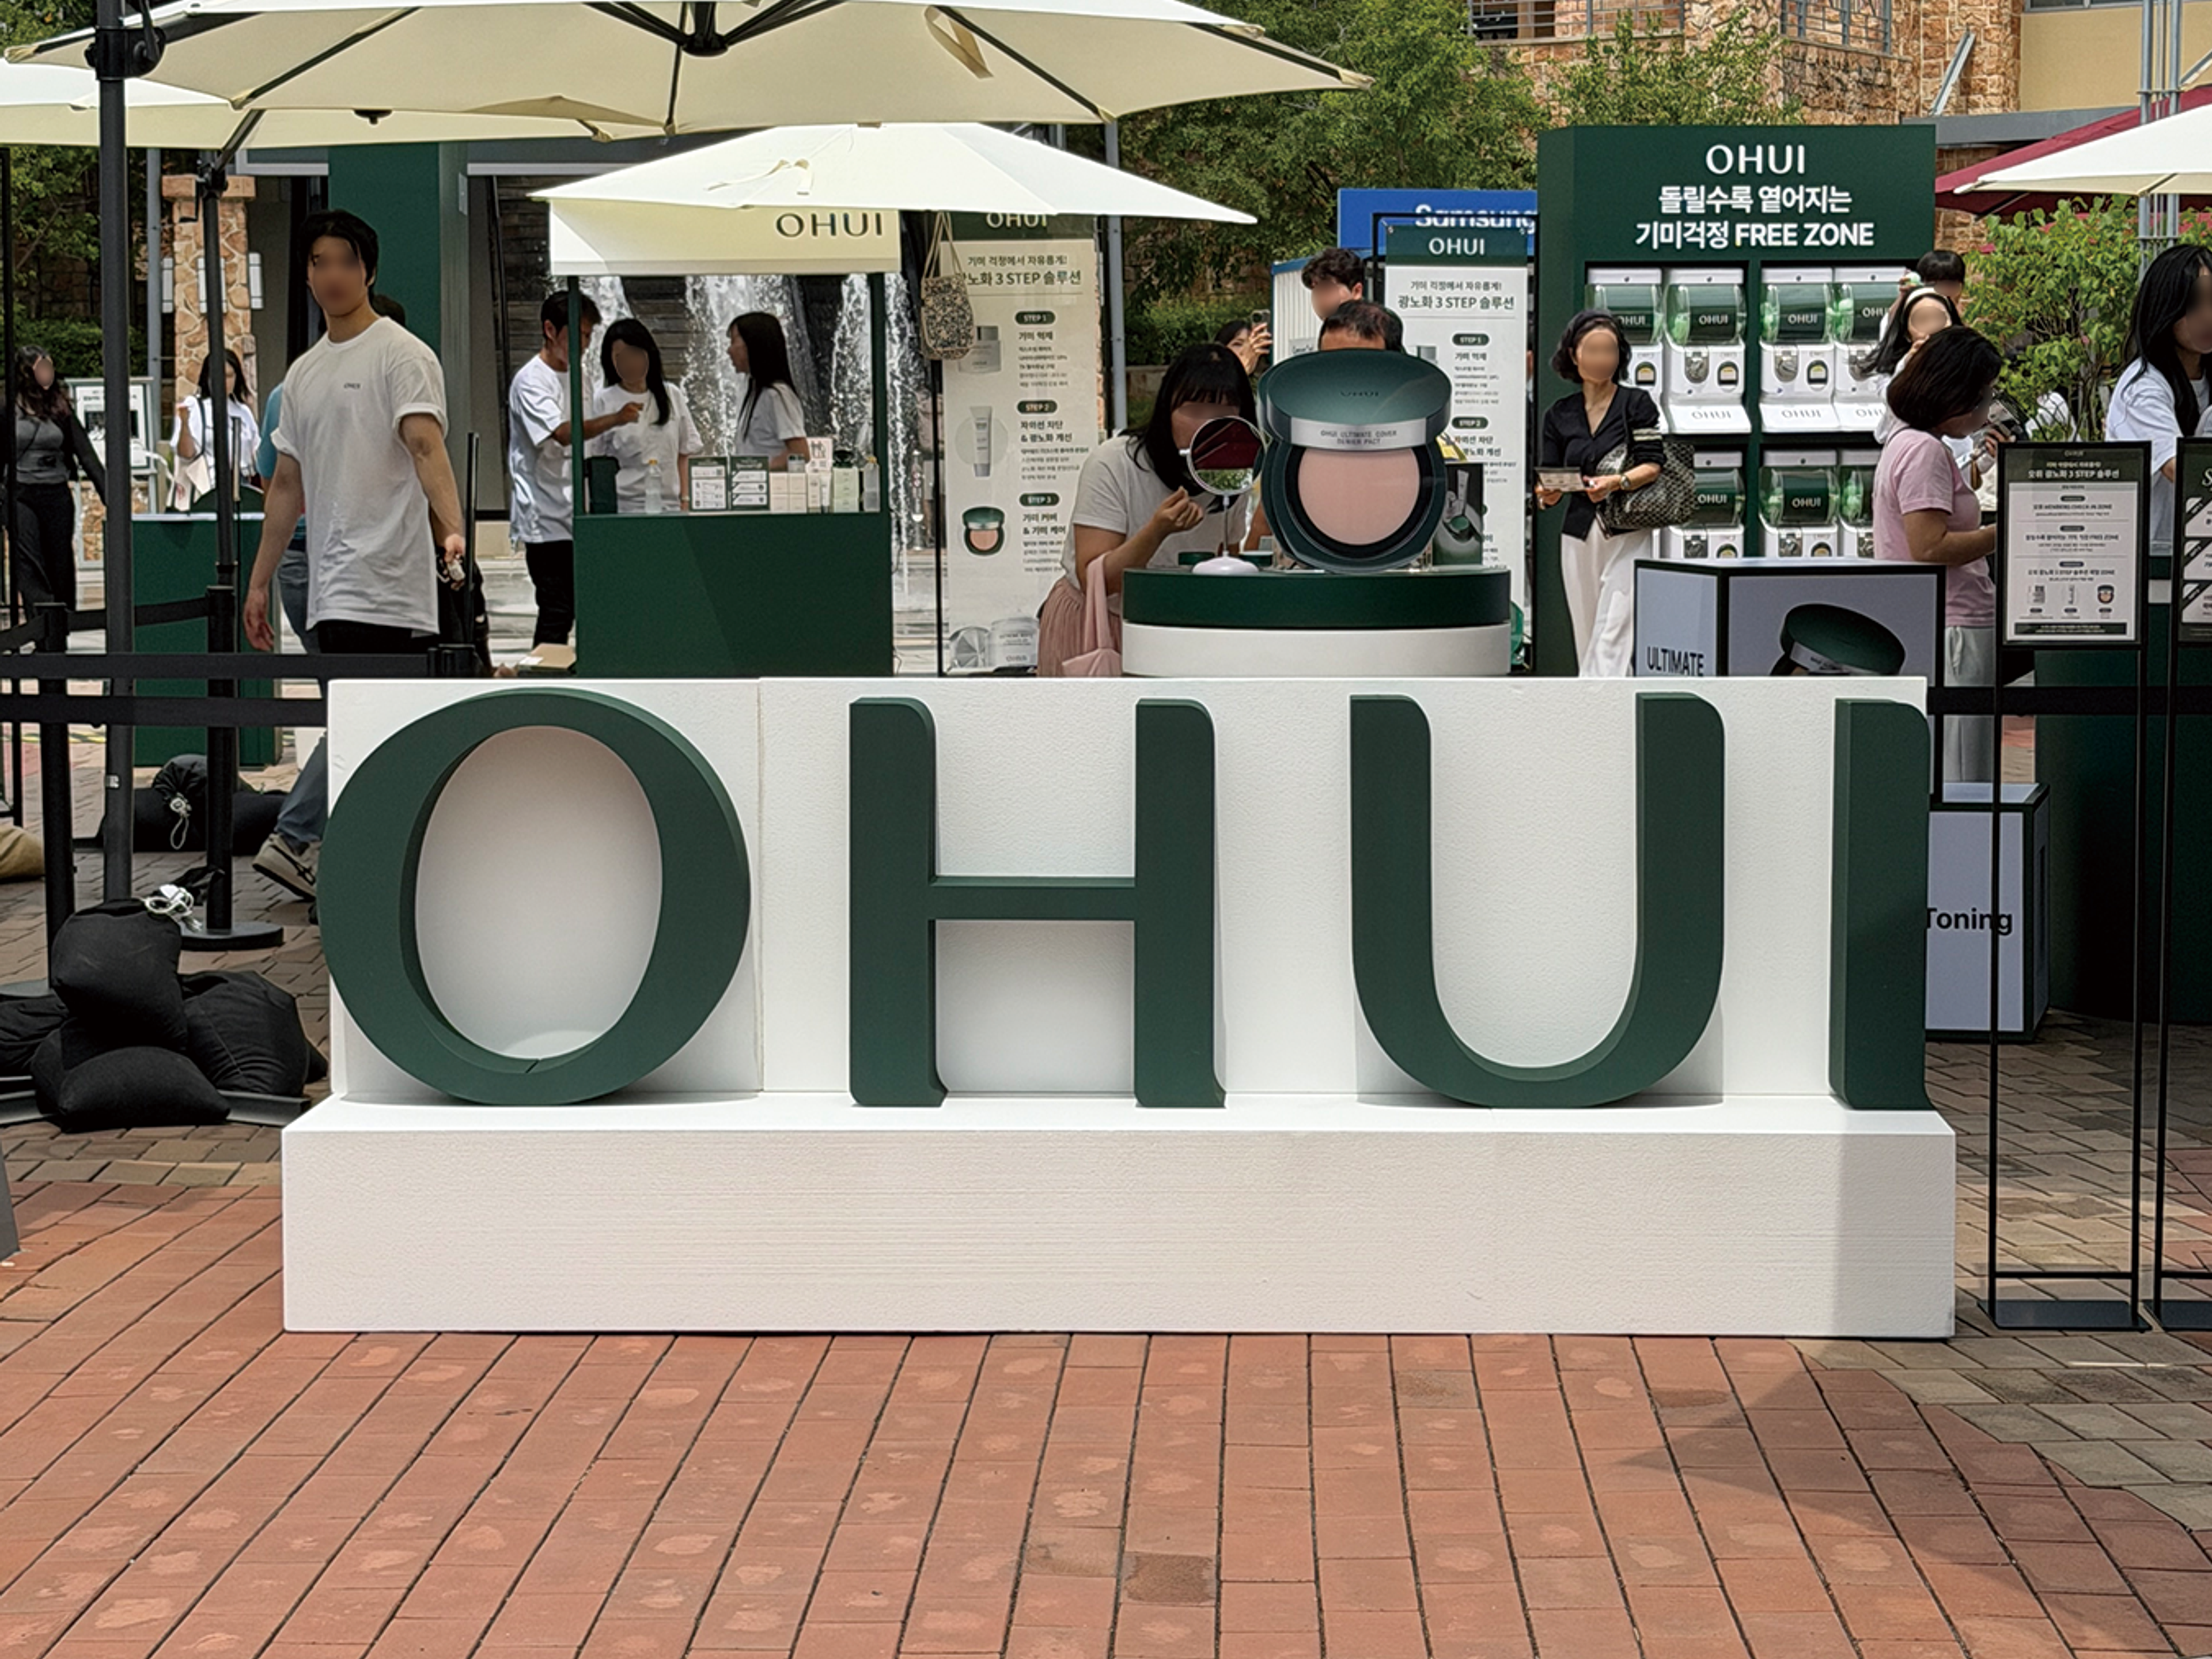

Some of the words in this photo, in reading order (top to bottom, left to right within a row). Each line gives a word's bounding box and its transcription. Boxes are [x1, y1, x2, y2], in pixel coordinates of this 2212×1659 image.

[1706, 144, 1805, 174] OHUI
[1658, 185, 1753, 214] 돌릴수록
[1758, 184, 1852, 214] 옅어지는
[776, 213, 882, 237] OHUI
[986, 213, 1047, 228] OHUI
[1415, 204, 1536, 233] Samsung
[1635, 221, 1729, 249] 기미걱정
[1734, 223, 1798, 247] FREE
[1804, 223, 1874, 247] ZONE
[1429, 237, 1485, 255] OHUI
[961, 271, 993, 286] 노화
[995, 272, 1004, 285] 3
[1007, 272, 1040, 285] STEP
[1044, 270, 1081, 285] 솔루션
[1398, 295, 1433, 309] 광노화
[1435, 297, 1442, 308] 3
[1445, 297, 1477, 308] STEP
[1480, 296, 1514, 310] 솔루션
[1024, 314, 1041, 322] STEP
[1699, 315, 1728, 324] OHUI
[1787, 314, 1818, 324] OHUI
[1862, 308, 1889, 317] OHU
[1692, 411, 1731, 419] OHUI
[1781, 409, 1821, 418] OHUI
[1697, 494, 1727, 504] OHUI
[1792, 498, 1821, 507] OHUI
[1647, 646, 1704, 676] ULTIMATE
[316, 688, 1938, 1109] OHUI
[1927, 907, 2012, 936] Toning
